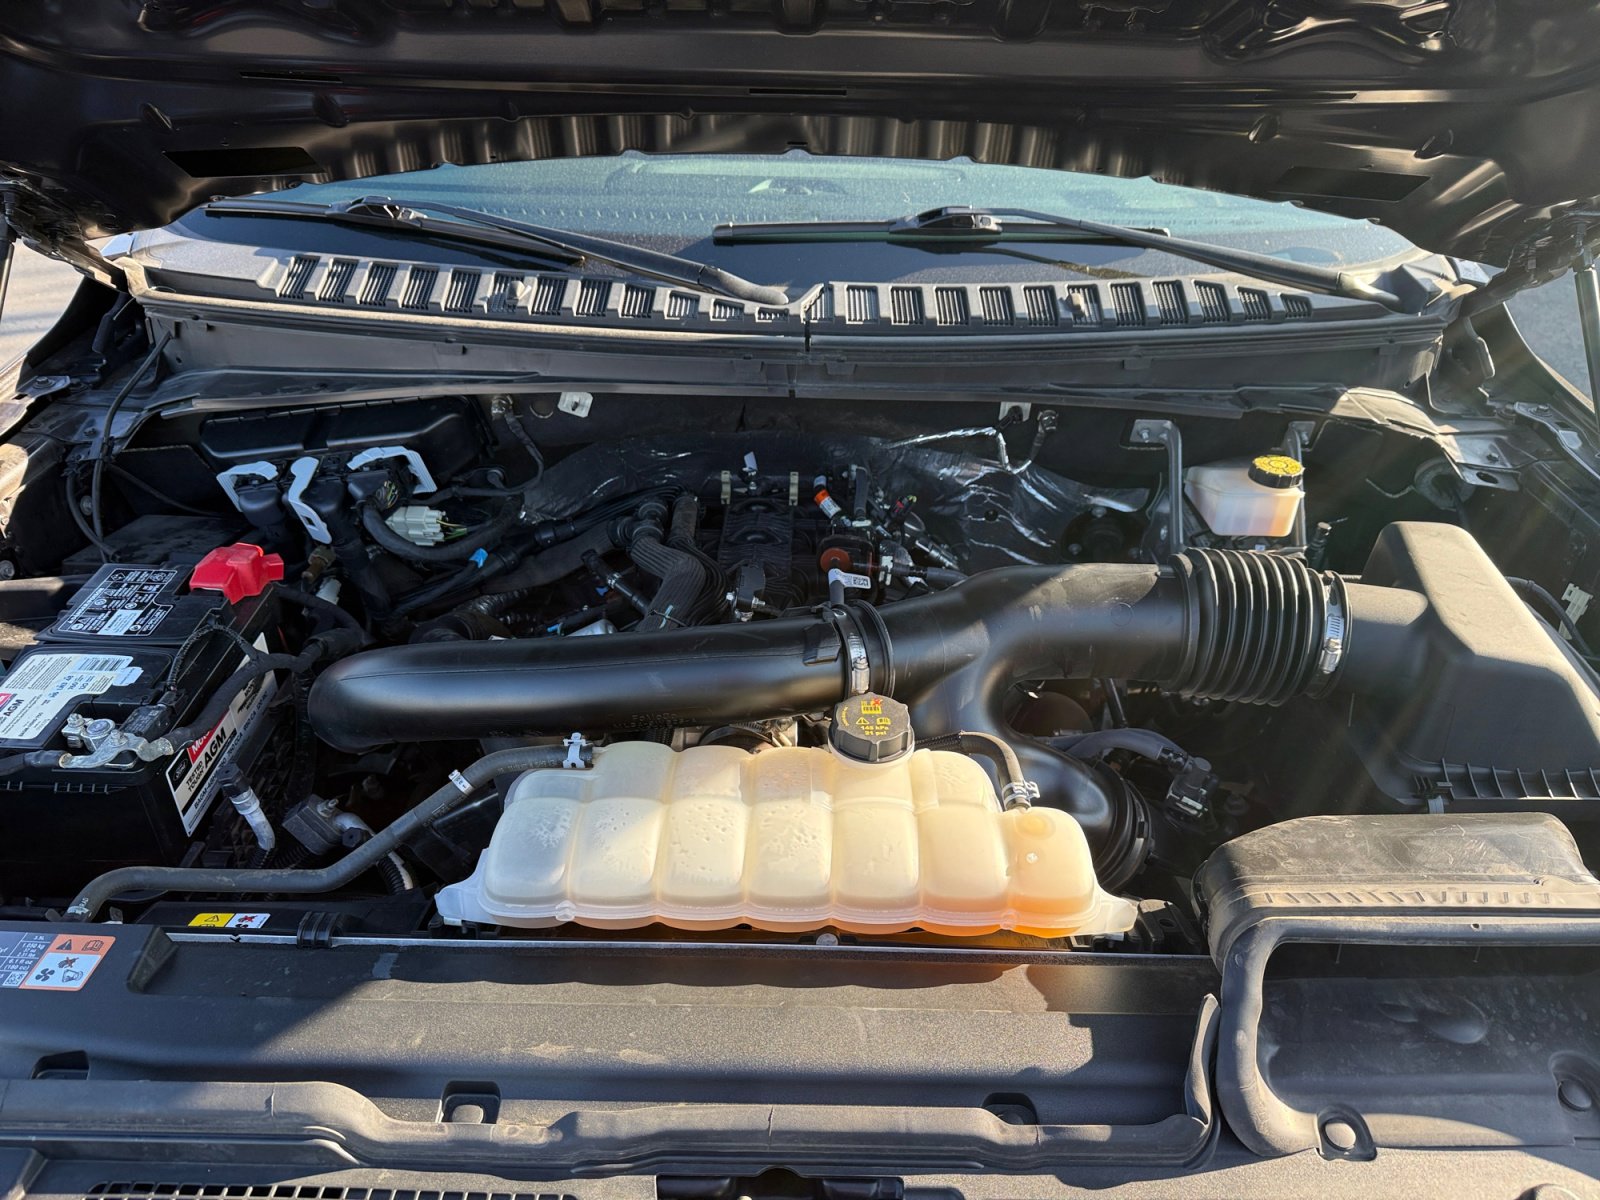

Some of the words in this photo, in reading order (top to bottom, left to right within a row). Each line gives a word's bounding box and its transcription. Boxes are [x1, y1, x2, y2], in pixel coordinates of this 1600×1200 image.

[4, 699, 24, 717] AGM
[203, 726, 227, 769] AGM
[186, 761, 203, 786] TESTED
